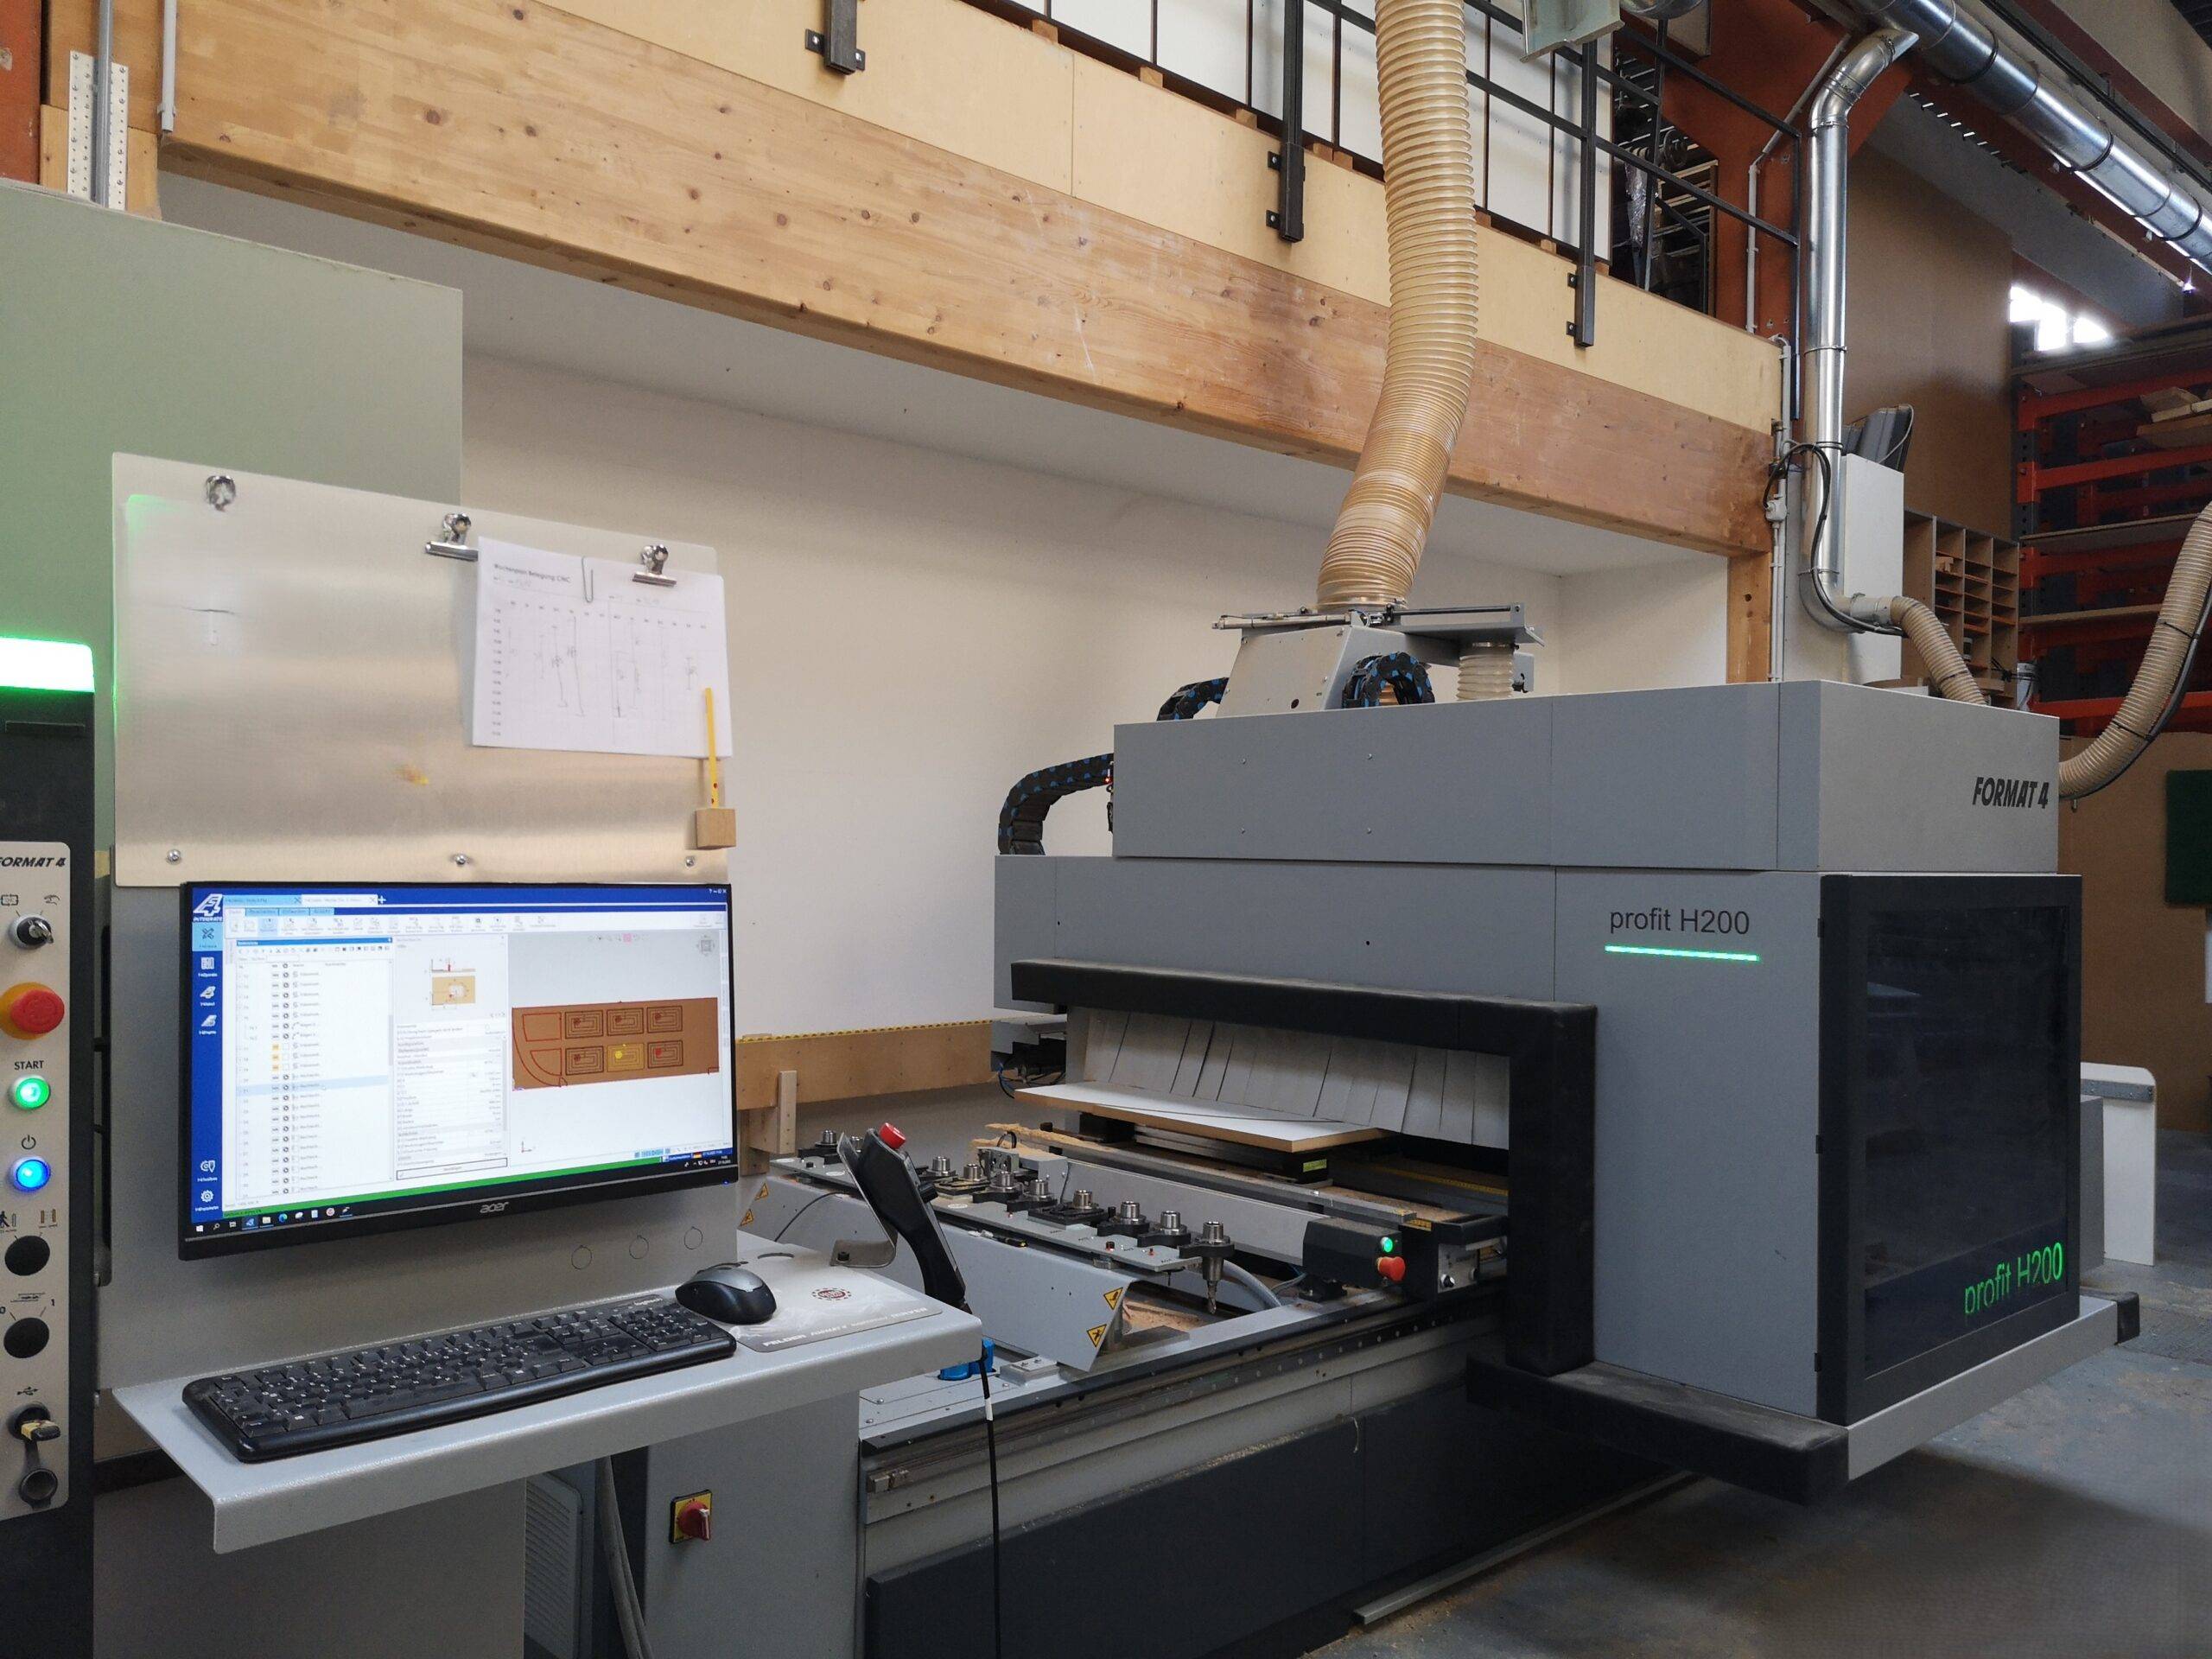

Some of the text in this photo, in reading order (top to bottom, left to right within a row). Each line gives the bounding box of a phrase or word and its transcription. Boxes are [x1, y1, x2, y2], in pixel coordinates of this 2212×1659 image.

[1972, 777, 2050, 809] FORMAT 4
[55, 857, 67, 868] 4
[1610, 907, 1750, 935] profit H200
[14, 1060, 45, 1071] START
[480, 1202, 510, 1214] acer
[1964, 1242, 2063, 1320] profit H200
